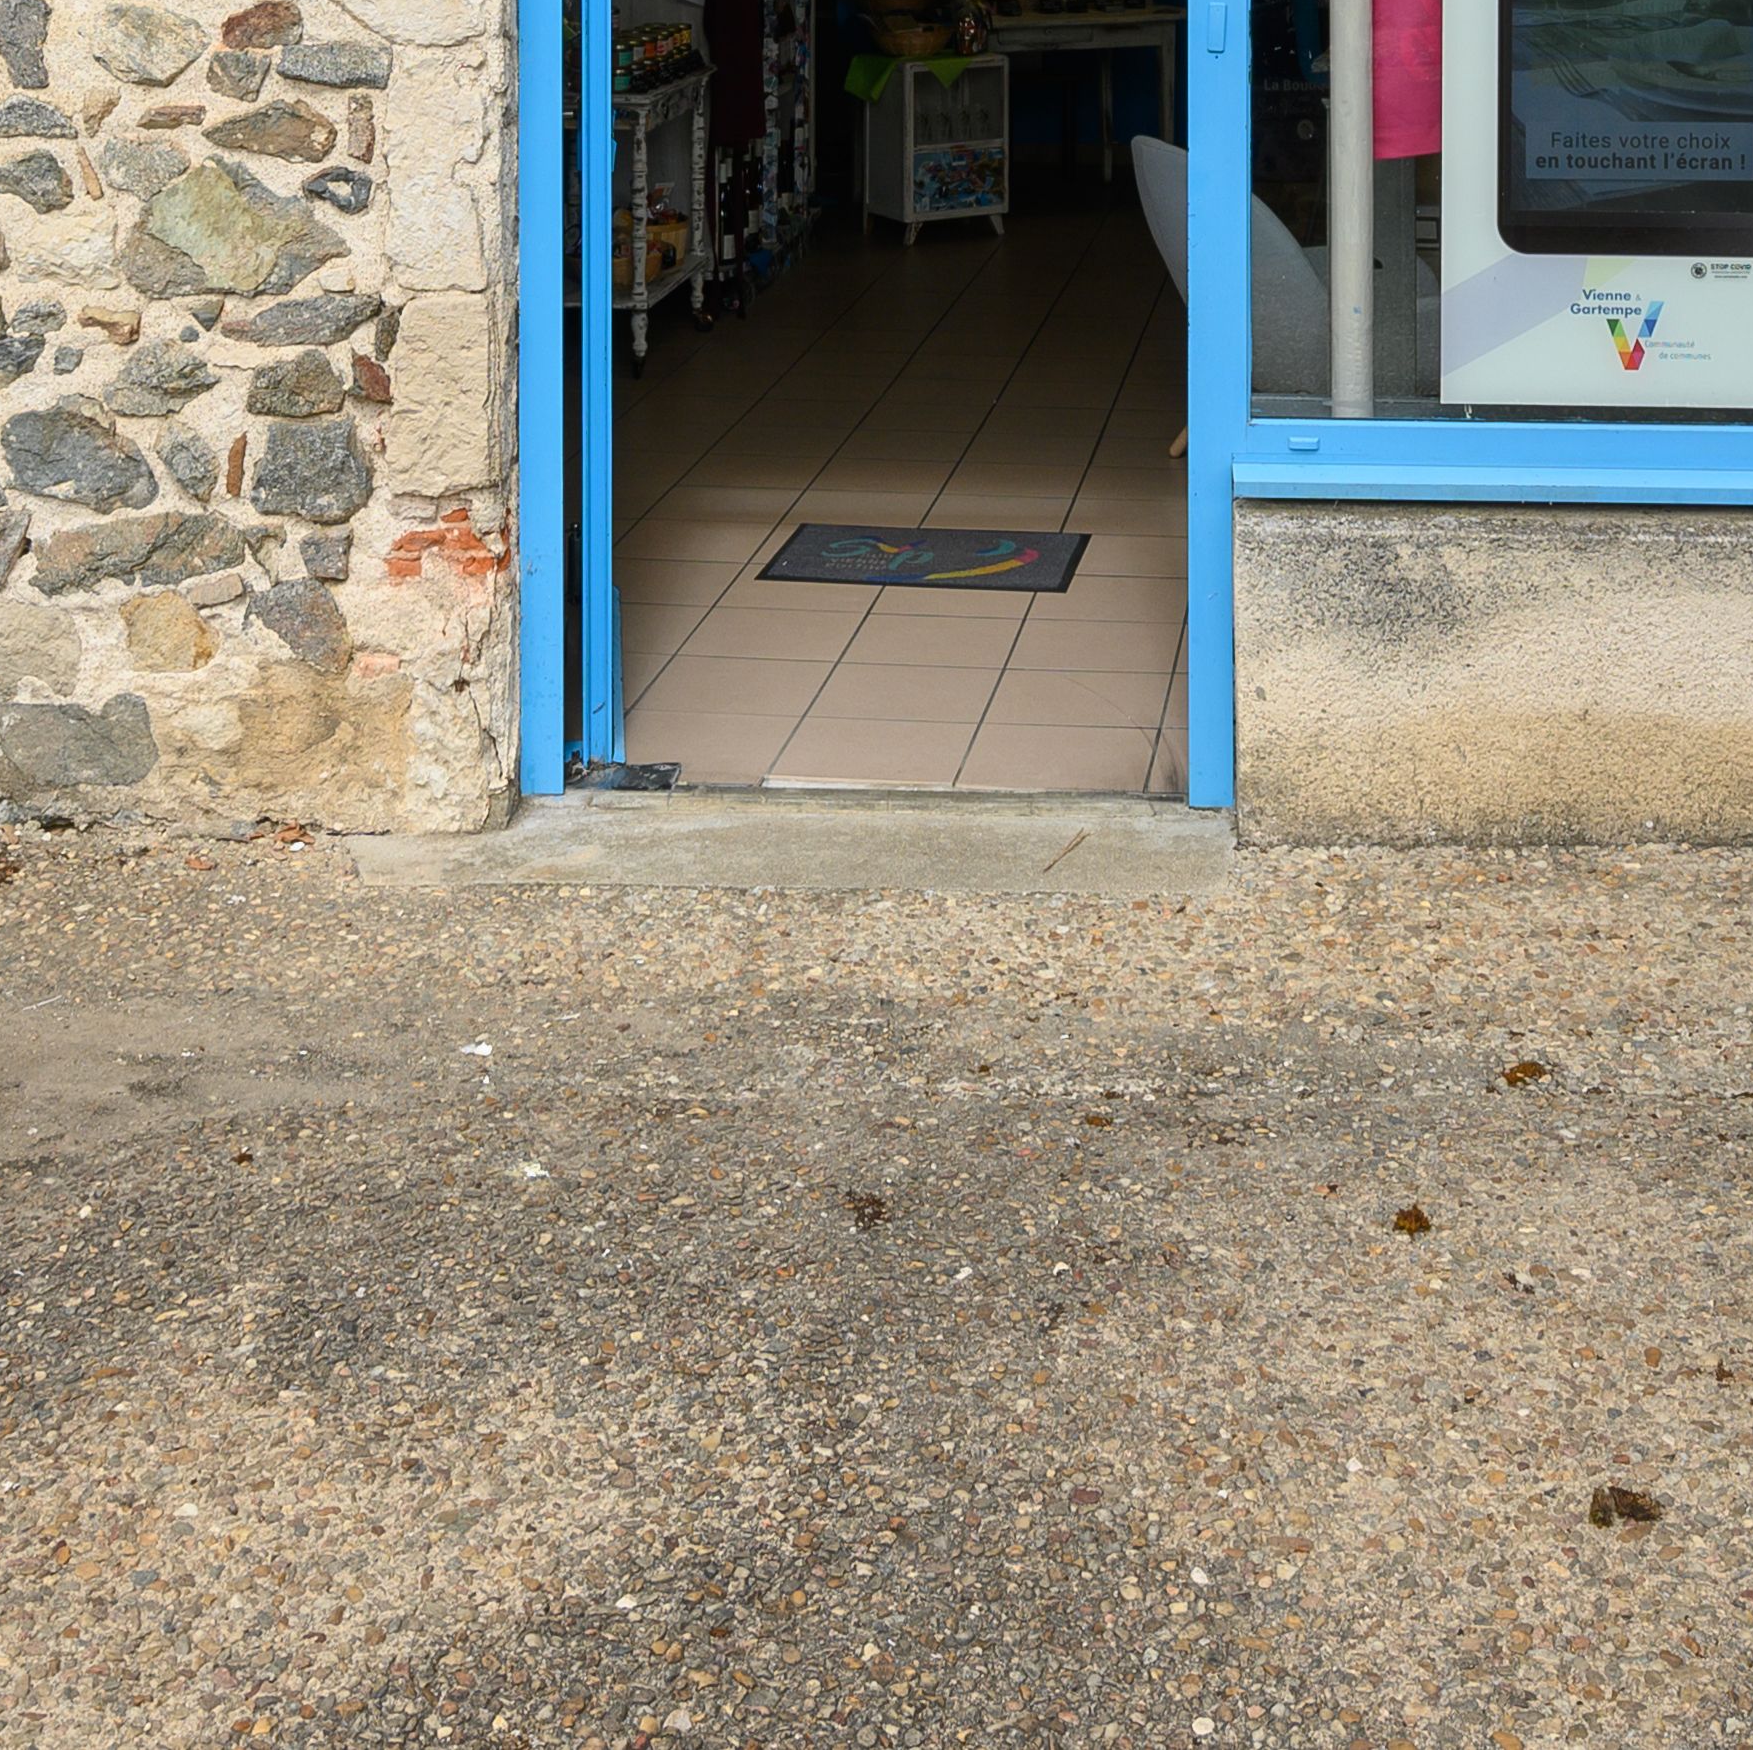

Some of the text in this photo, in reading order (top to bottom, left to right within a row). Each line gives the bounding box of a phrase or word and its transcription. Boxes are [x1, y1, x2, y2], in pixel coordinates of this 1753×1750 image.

[1550, 131, 1730, 150] Faites votre choix
[1535, 155, 1559, 170] en
[1566, 151, 1655, 170] touchant
[1663, 151, 1732, 171] l'écran
[1582, 288, 1632, 301] Vienne
[1570, 303, 1642, 318] Gartempe
[1644, 339, 1695, 349] Communauté
[1659, 351, 1668, 360] de
